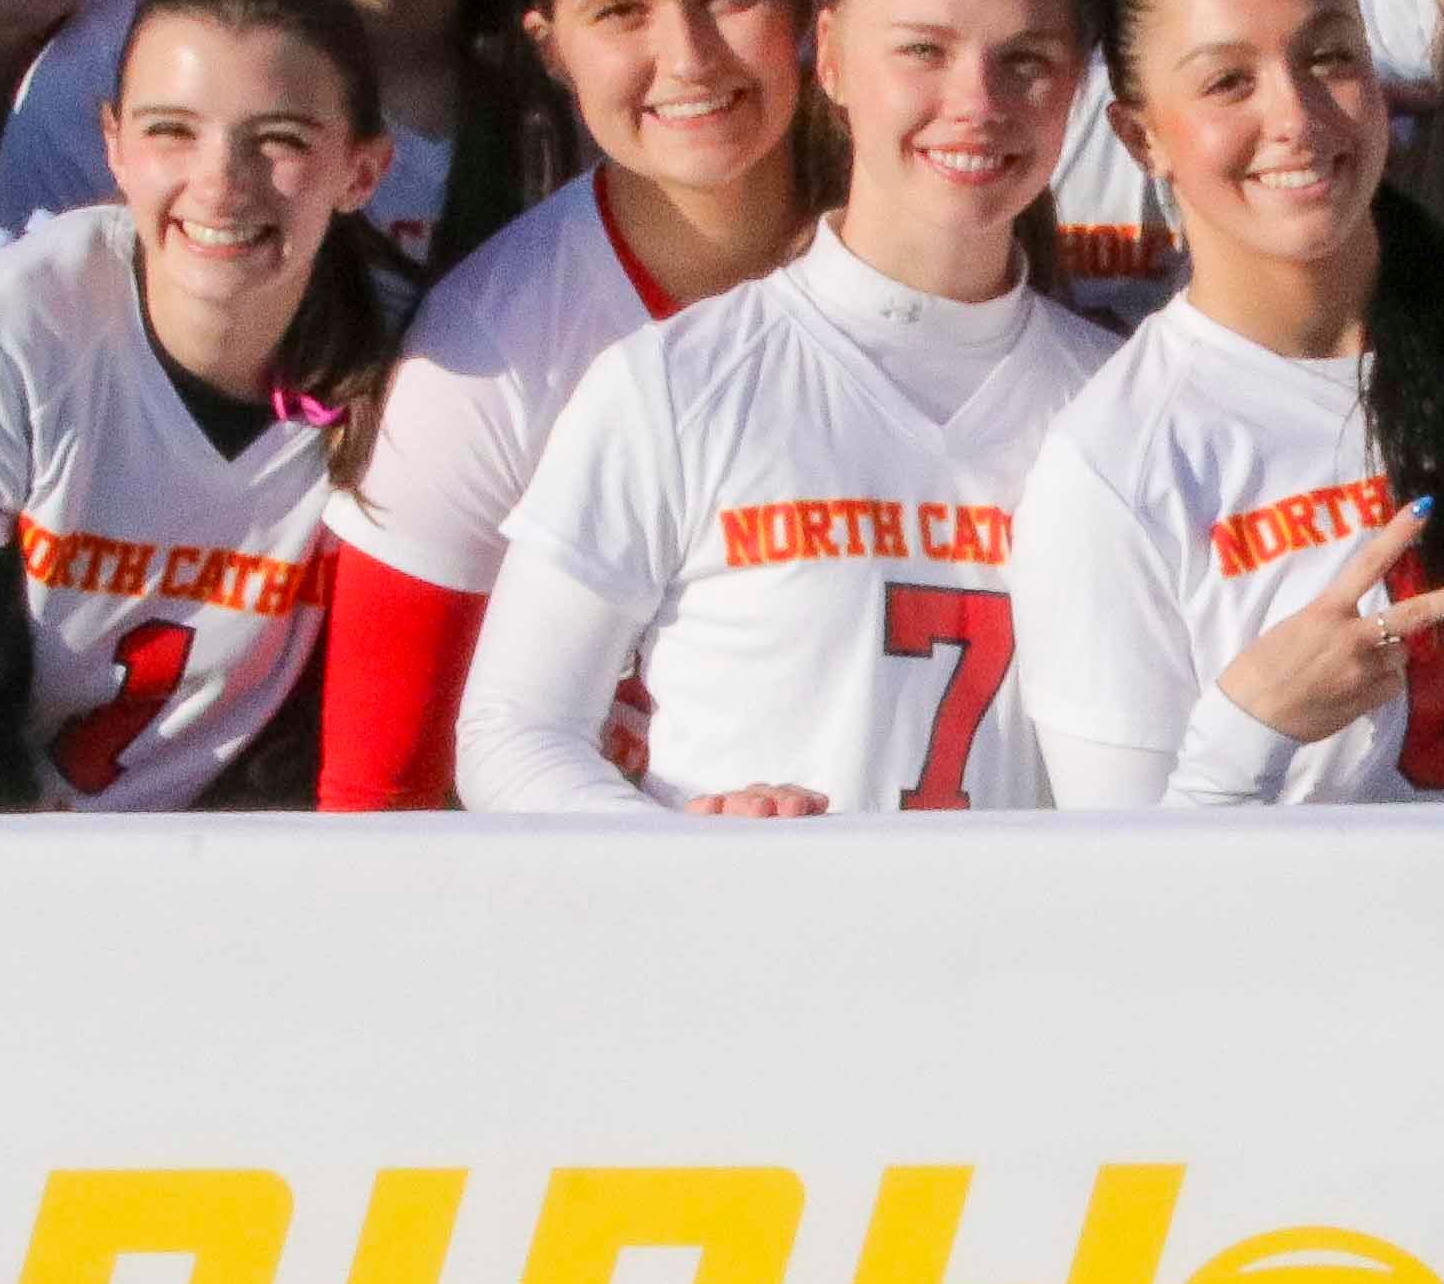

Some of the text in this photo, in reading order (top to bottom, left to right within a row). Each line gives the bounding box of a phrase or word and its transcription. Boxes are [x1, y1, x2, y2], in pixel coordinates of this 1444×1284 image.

[720, 499, 909, 567] NORTH
[1212, 475, 1398, 578] NORTH
[883, 581, 1016, 811] 7
